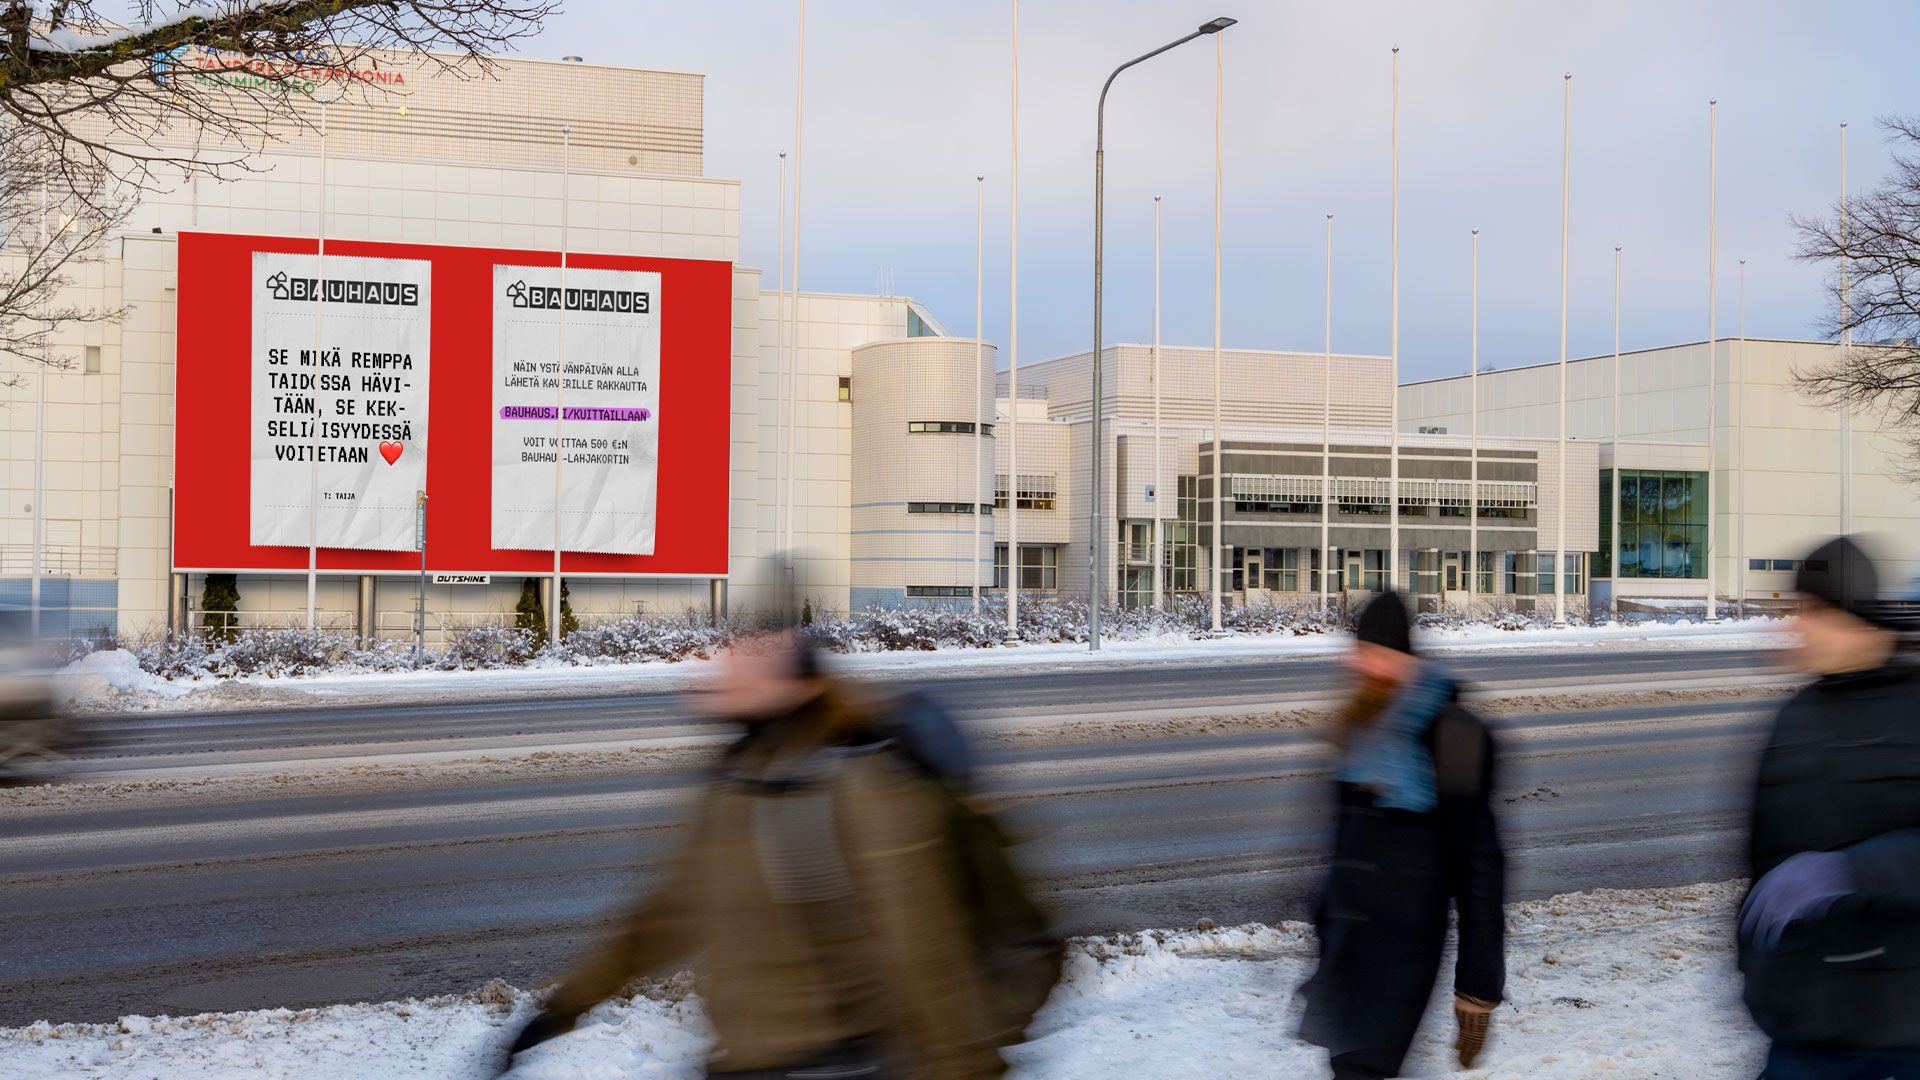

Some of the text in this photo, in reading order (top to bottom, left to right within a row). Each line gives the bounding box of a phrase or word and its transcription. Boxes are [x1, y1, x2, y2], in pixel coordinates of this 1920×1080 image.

[290, 278, 418, 306] BAUHAUS
[529, 286, 649, 314] BAUHAUS
[268, 347, 412, 370] SE MIKÄ REMPPA
[513, 360, 536, 373] NÄIN
[616, 366, 639, 376] ALLA
[362, 372, 410, 393] HÄVI-
[505, 374, 647, 392] LÄHETÄ KAVERILLE RAKKAUTTA
[274, 393, 405, 418] TÄÄN, SE KEK-
[523, 437, 545, 448] VOIT
[591, 439, 608, 449] 500
[612, 440, 628, 450] €:N
[275, 445, 368, 463] VOITETAAN
[521, 452, 629, 464] BAUHAU-LAHJAKORTIN
[324, 492, 356, 500] T: TAIJA
[437, 575, 486, 583] OUTSHINE
